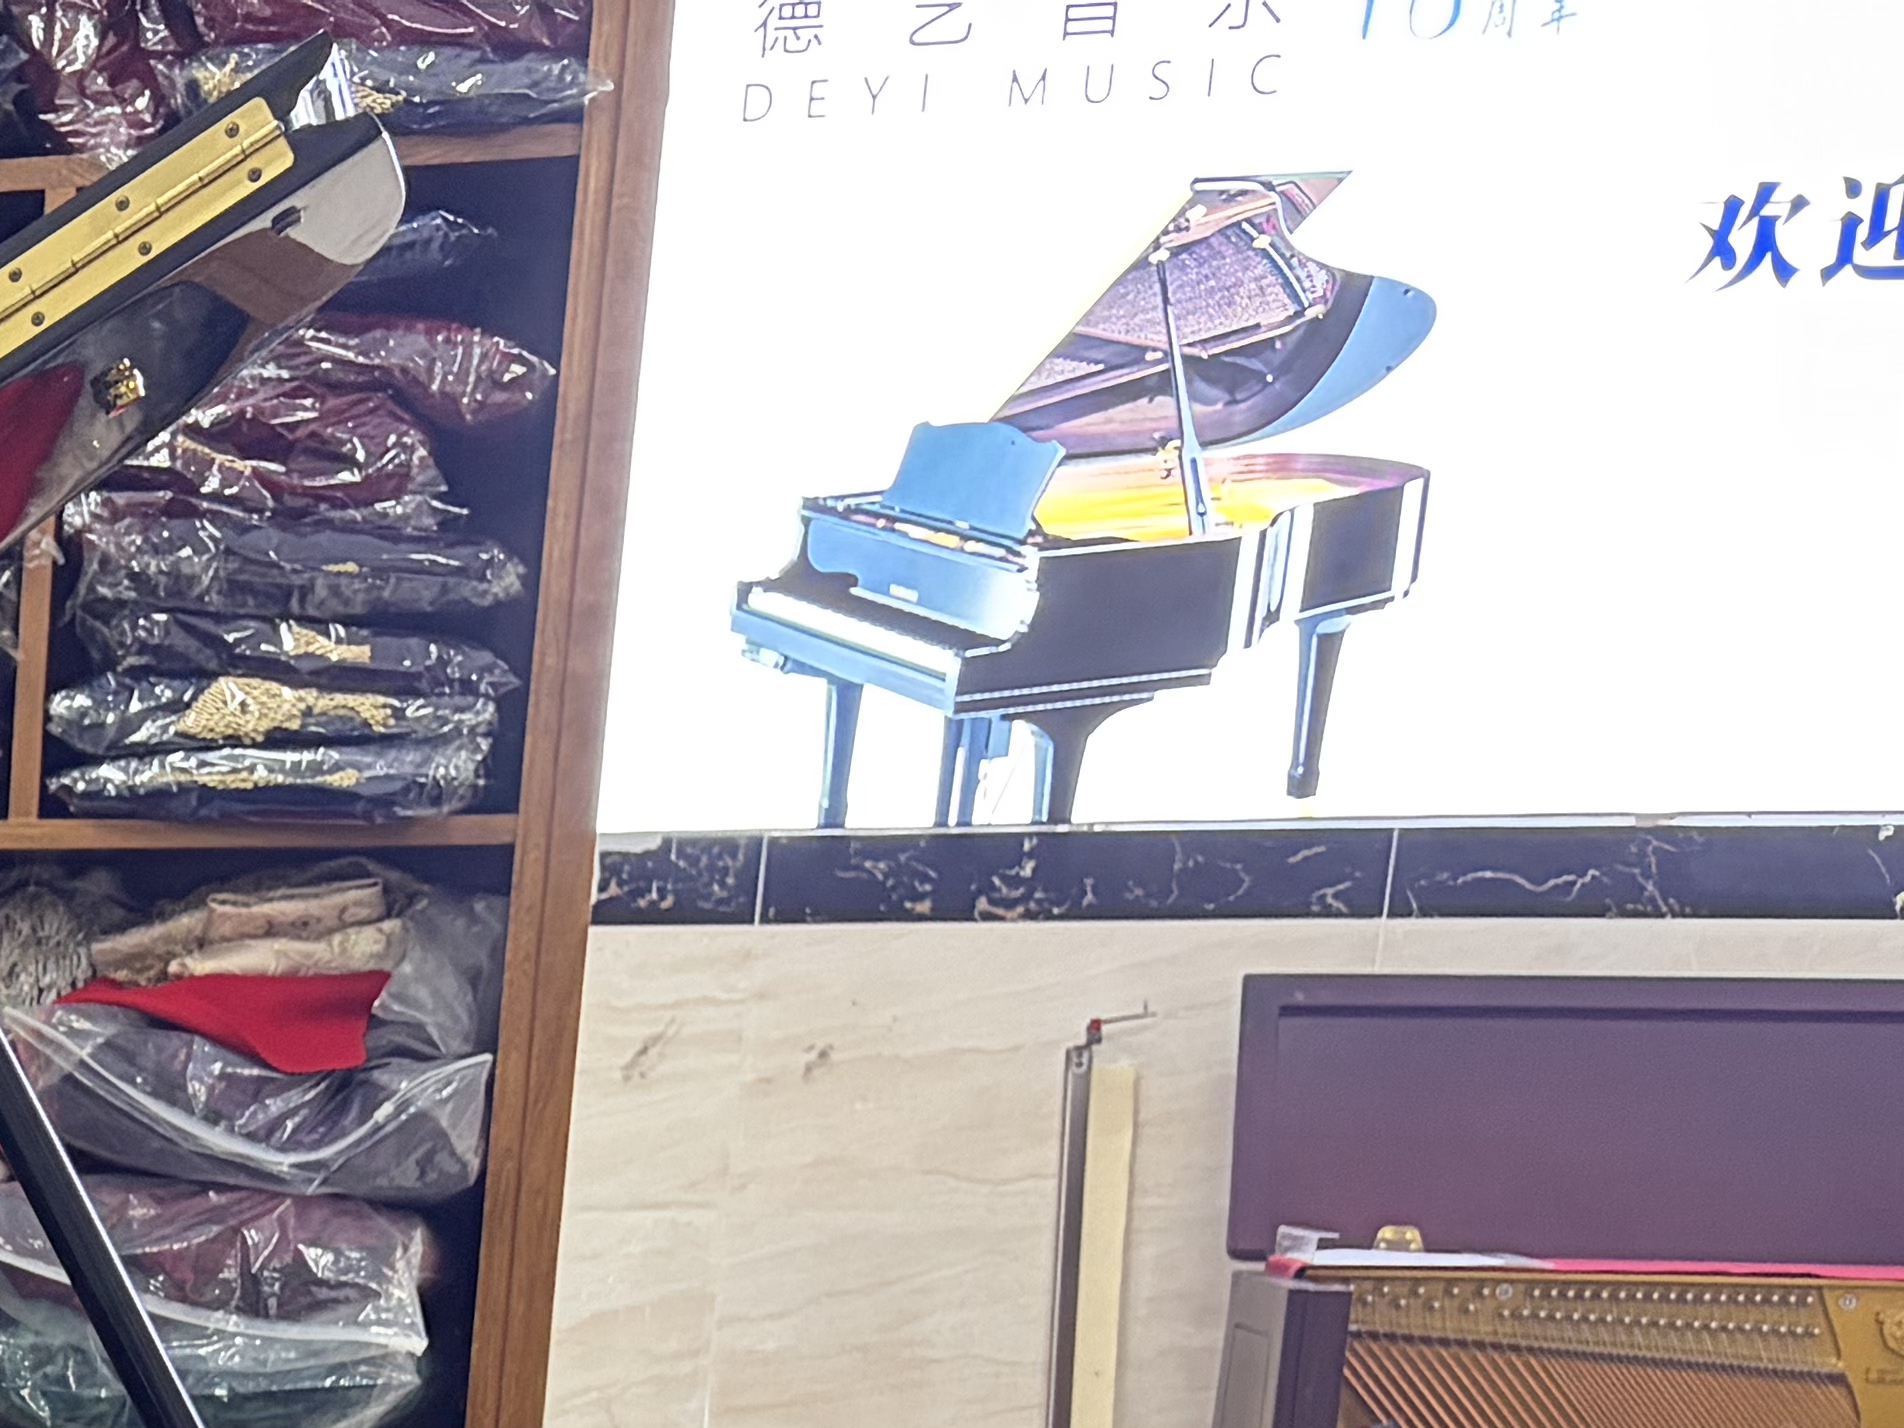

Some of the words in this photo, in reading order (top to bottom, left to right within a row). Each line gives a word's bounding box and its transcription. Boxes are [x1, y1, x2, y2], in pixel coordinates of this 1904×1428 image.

[742, 73, 930, 122] DEYI
[1008, 54, 1282, 107] MUSIC
[1683, 174, 1904, 293] 欢迎
